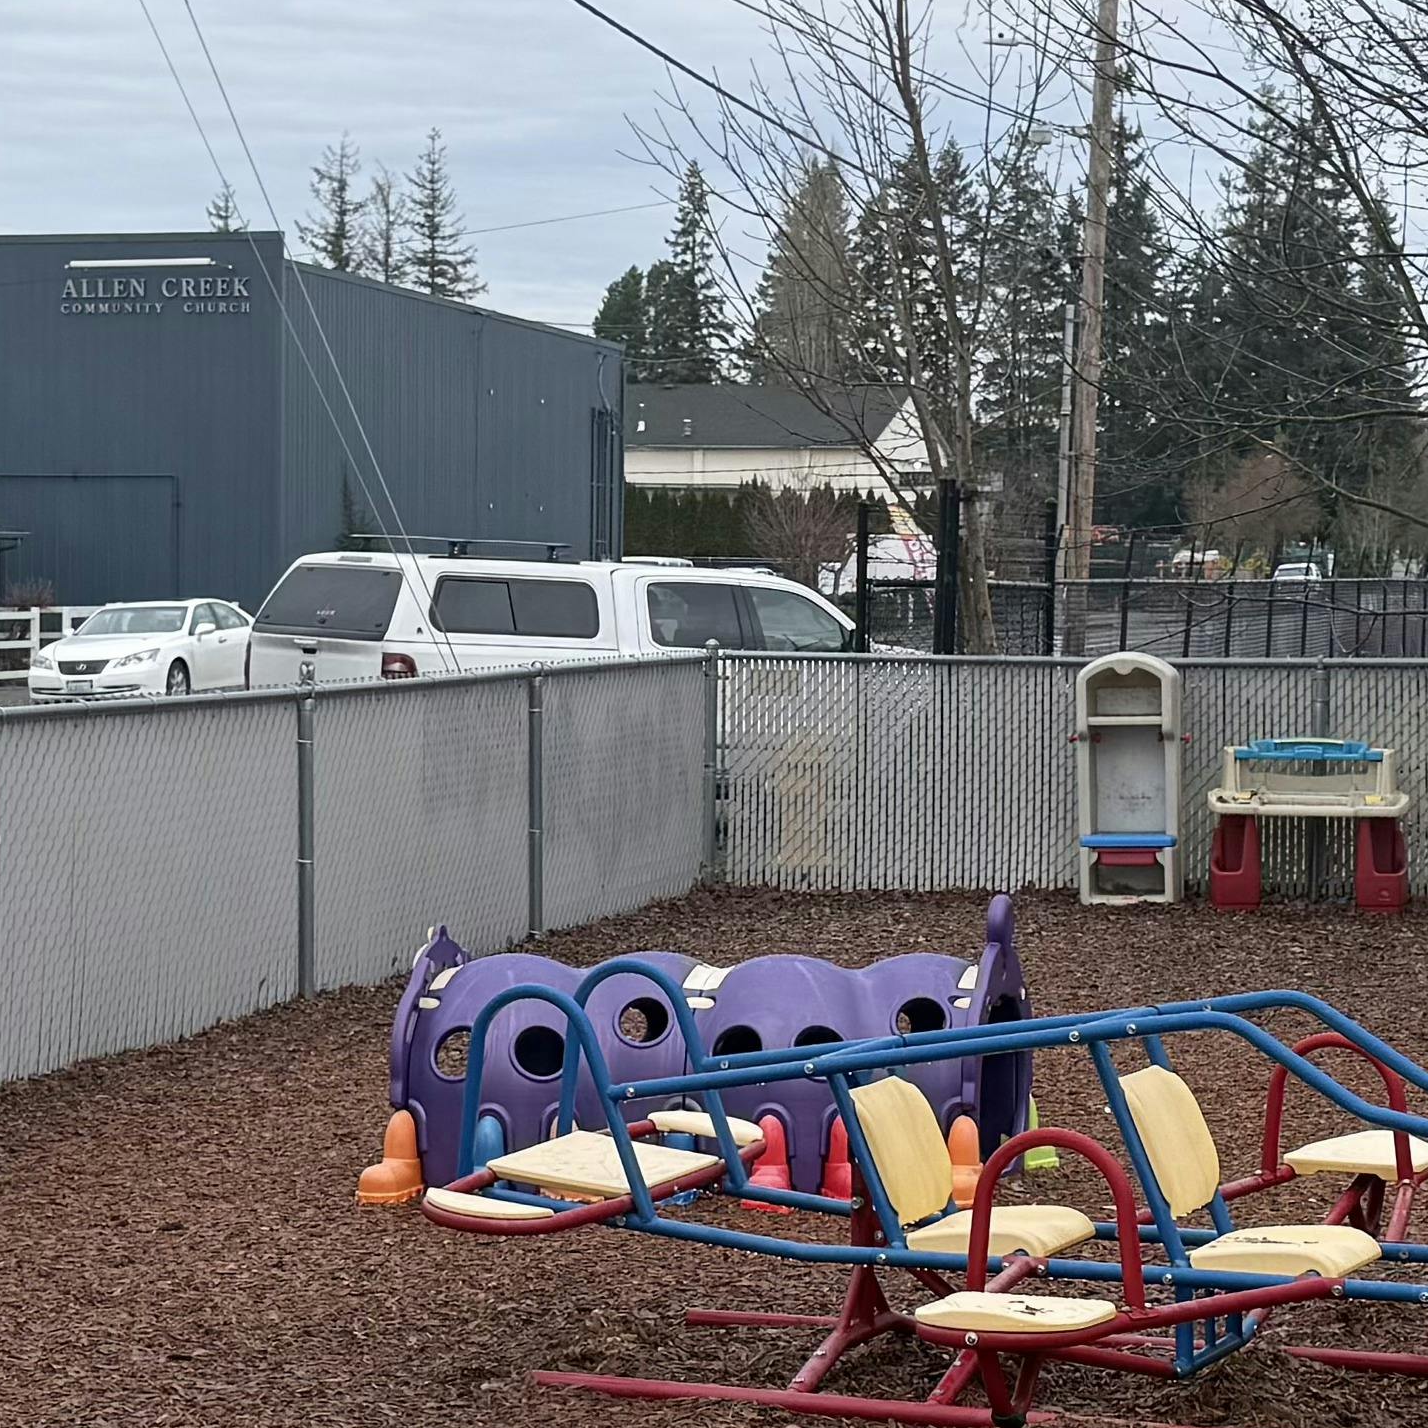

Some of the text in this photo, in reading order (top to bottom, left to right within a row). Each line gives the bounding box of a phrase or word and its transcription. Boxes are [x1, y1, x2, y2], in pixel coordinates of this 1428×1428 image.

[61, 276, 250, 298] ALLEN CREEK
[60, 301, 250, 314] COMMUNITY CHURCH
